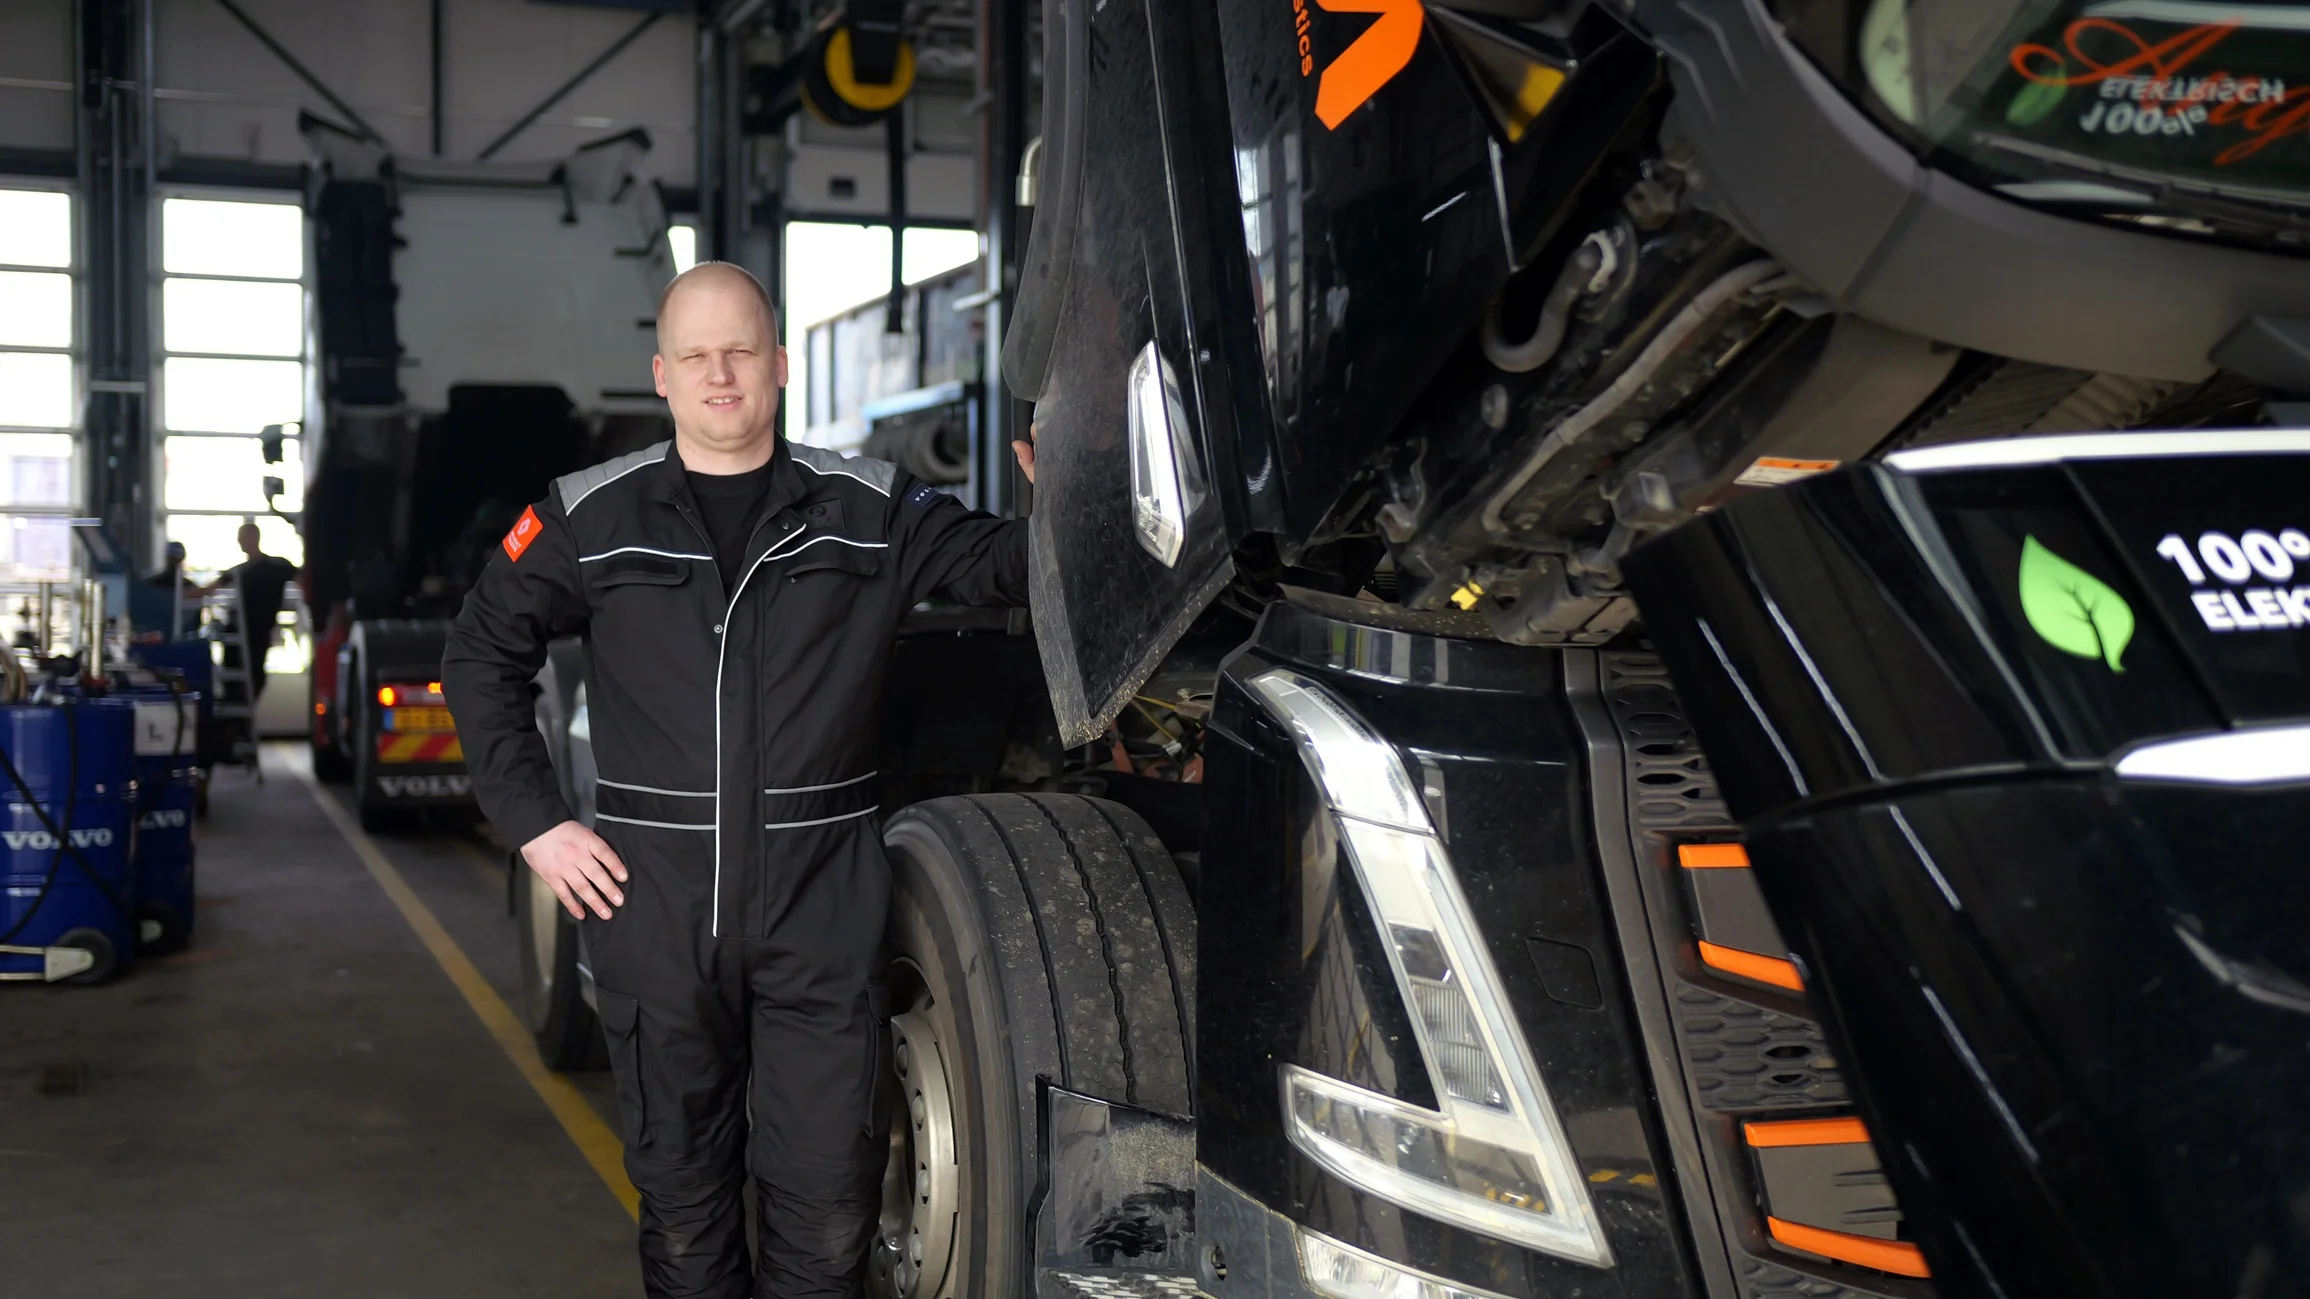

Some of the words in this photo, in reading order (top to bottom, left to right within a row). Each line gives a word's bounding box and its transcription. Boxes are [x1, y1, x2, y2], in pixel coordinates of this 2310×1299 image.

[915, 486, 931, 501] VOL
[377, 775, 472, 797] VOLV
[139, 809, 186, 829] LVO
